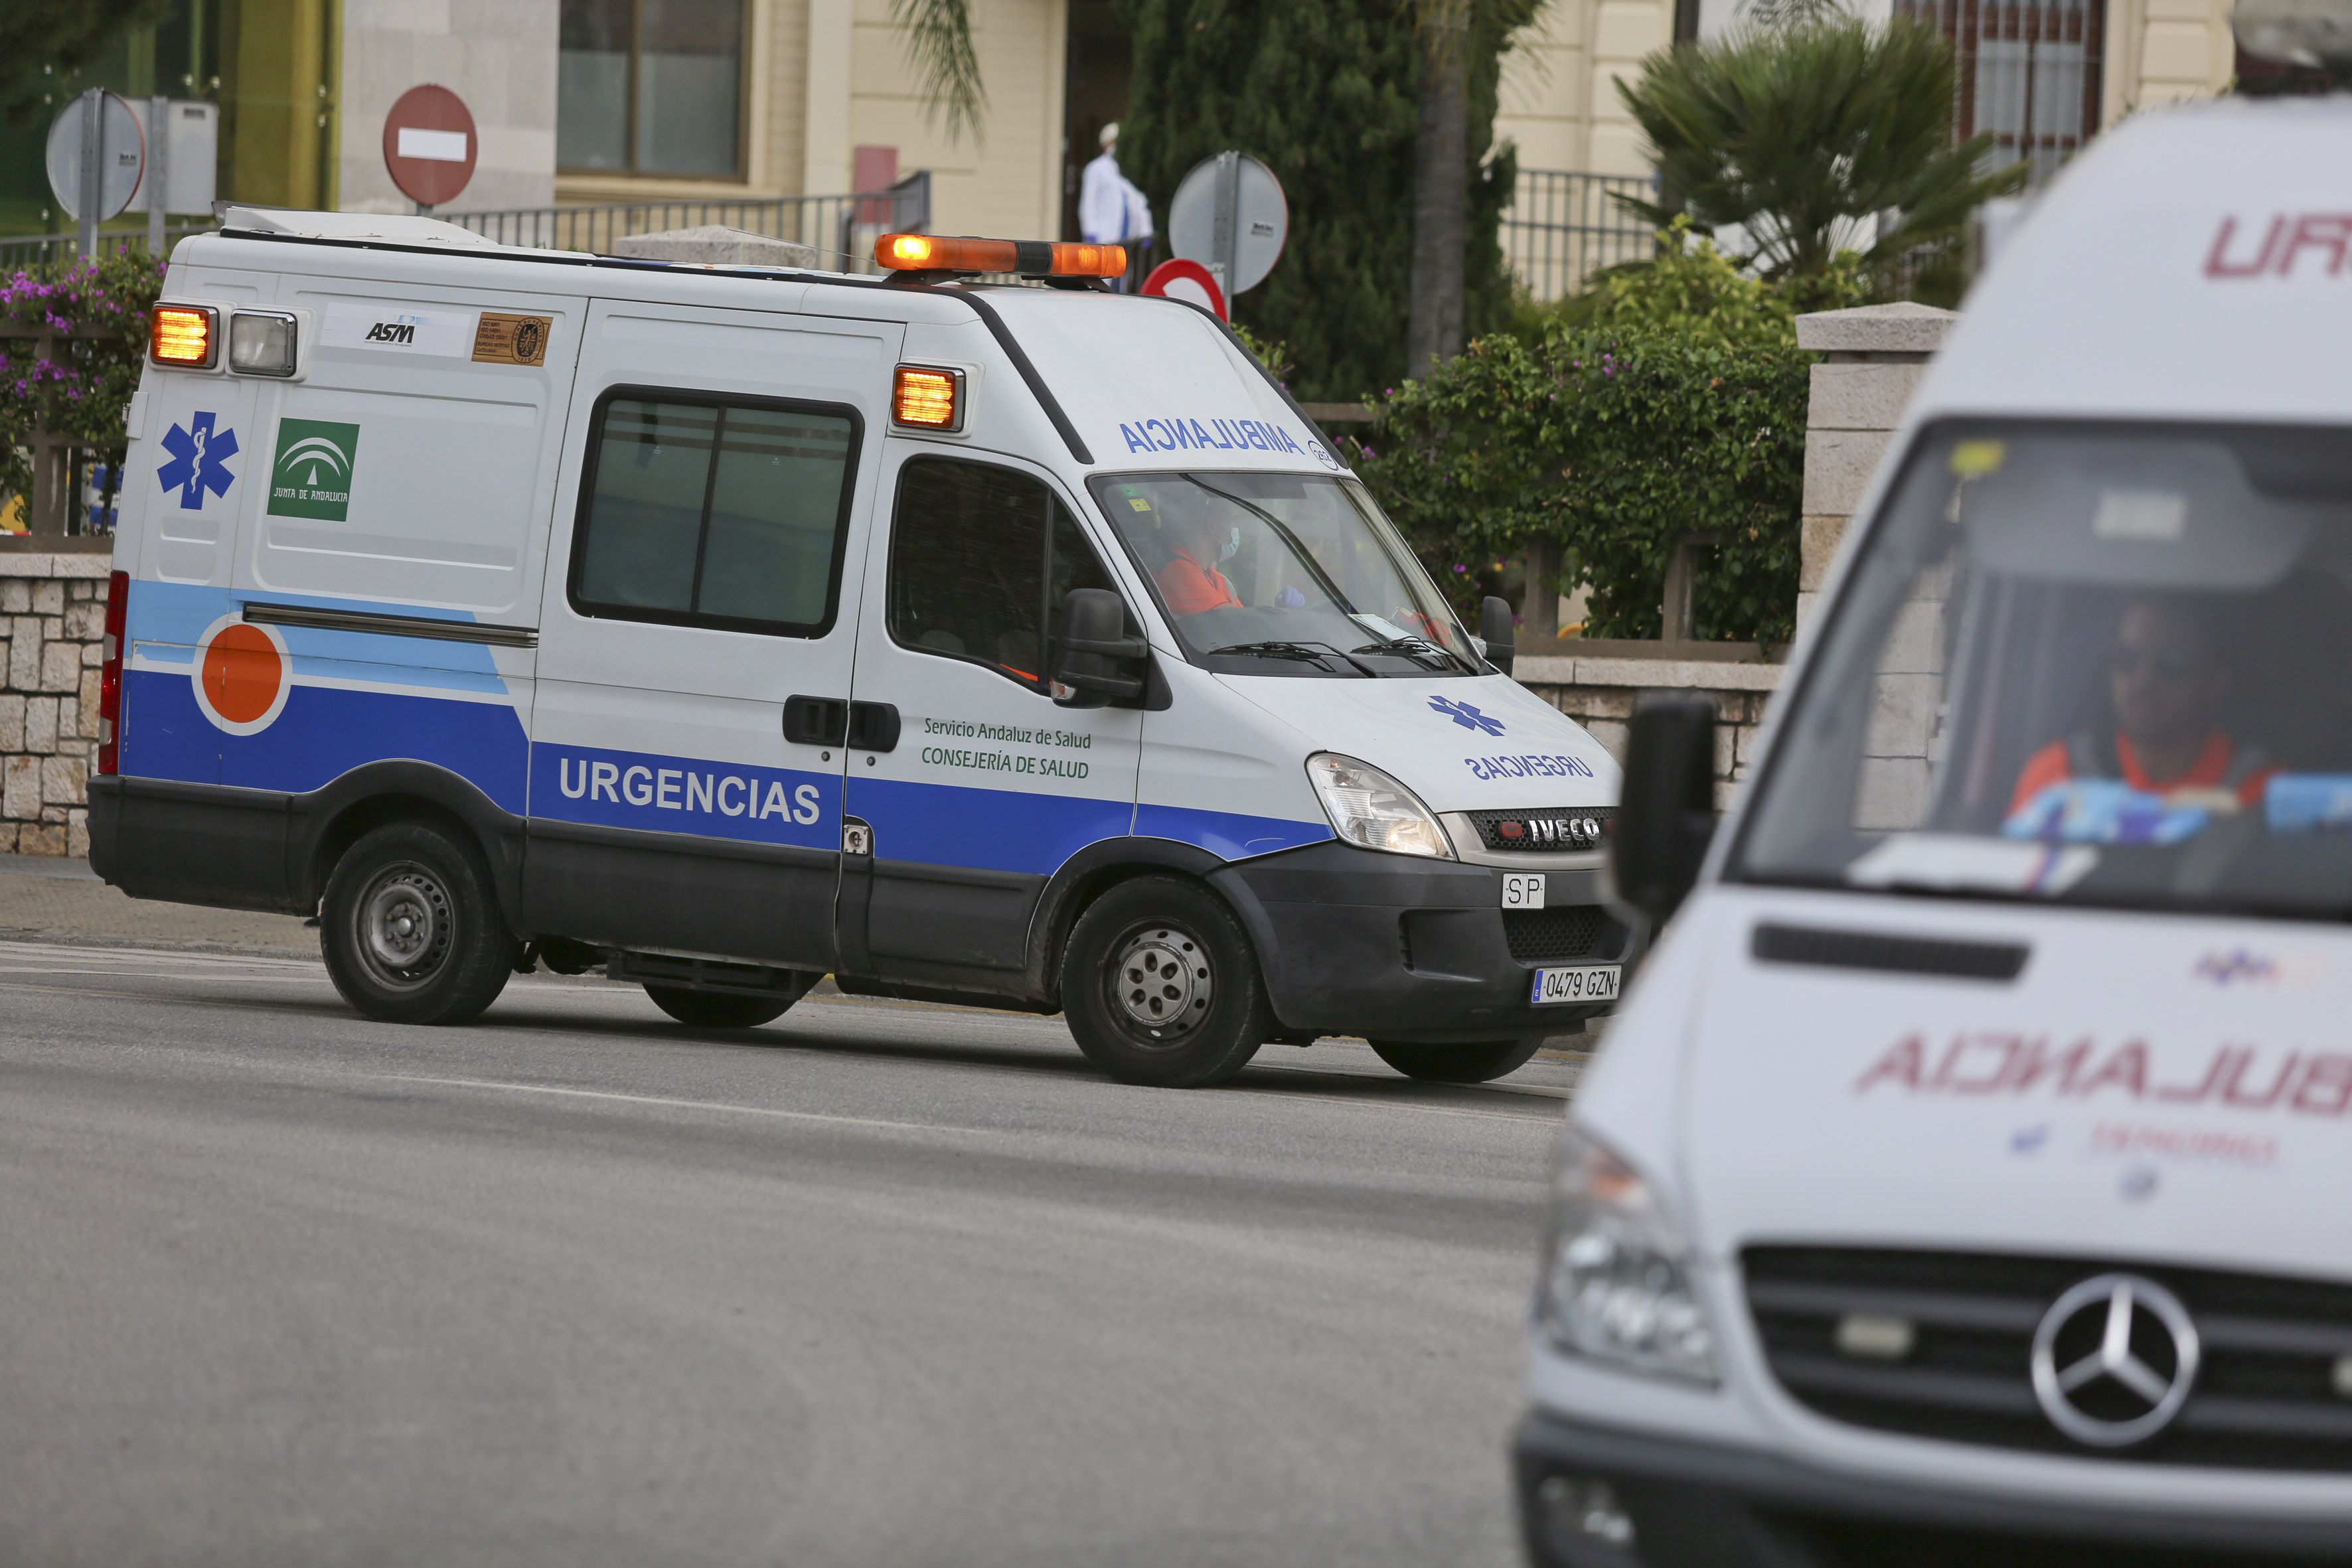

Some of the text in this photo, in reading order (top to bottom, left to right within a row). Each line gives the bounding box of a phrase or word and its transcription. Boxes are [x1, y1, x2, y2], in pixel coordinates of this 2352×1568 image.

[365, 323, 415, 343] ASM
[1314, 449, 1332, 462] 262
[274, 487, 348, 502] JUNTA DE ANDALUCIA
[925, 718, 1091, 749] Servicio Andaluz de Salud
[921, 747, 1089, 779] CONSEJERÍA DE SALUD
[560, 758, 819, 825] URGENCIAS
[1528, 818, 1600, 842] IVECO
[1508, 878, 1540, 903] SP
[1546, 972, 1583, 997] 0479
[1587, 970, 1615, 996] GZN
